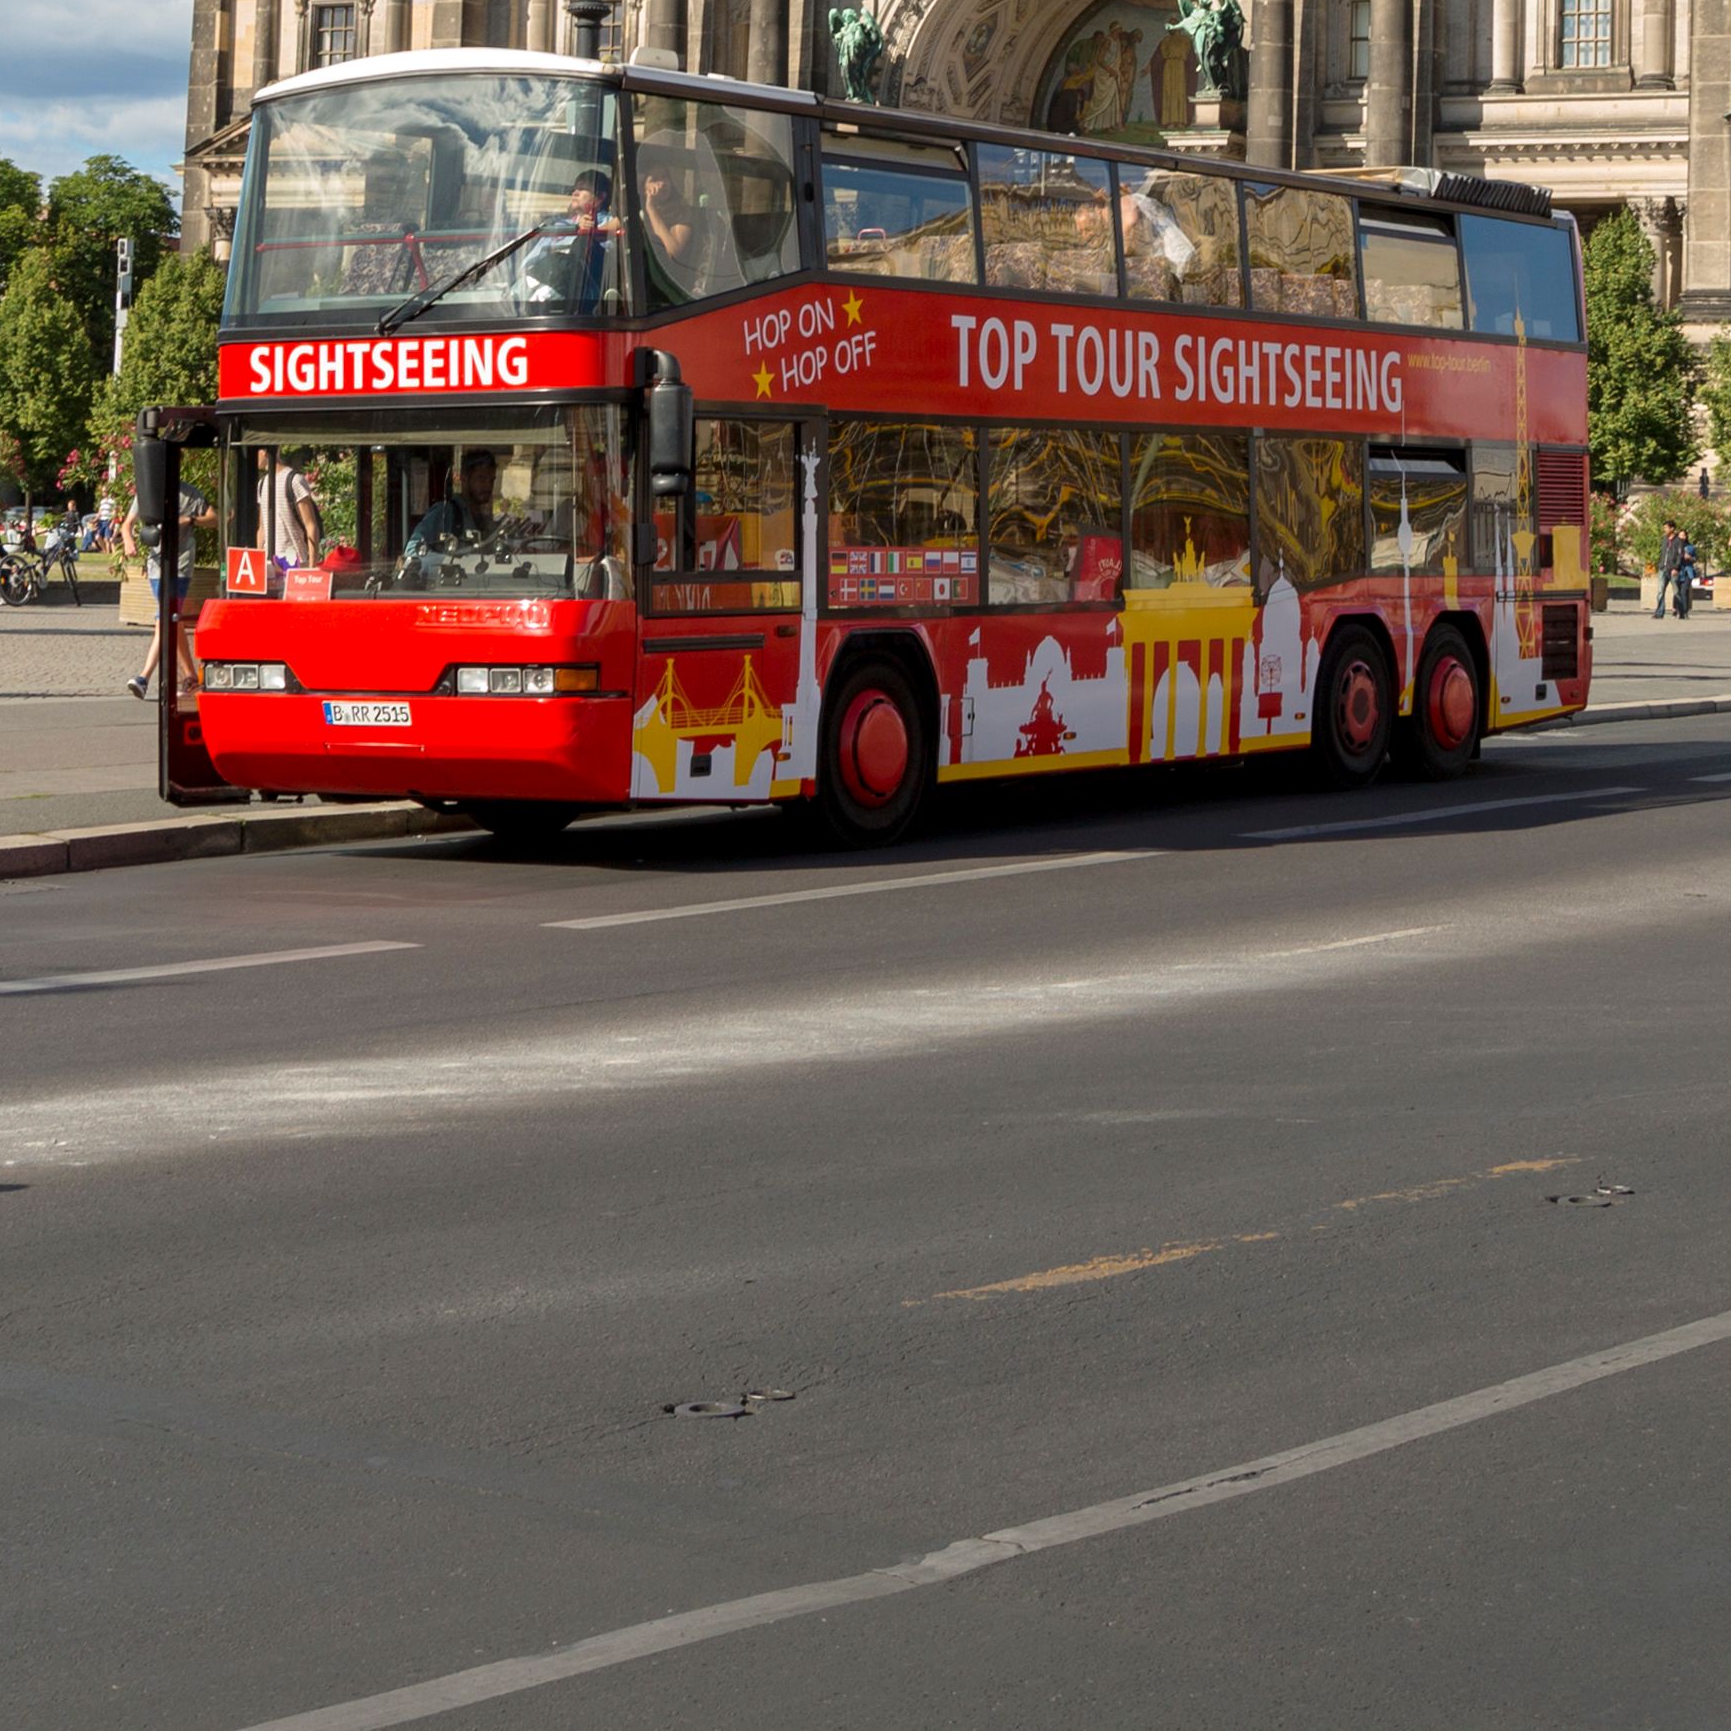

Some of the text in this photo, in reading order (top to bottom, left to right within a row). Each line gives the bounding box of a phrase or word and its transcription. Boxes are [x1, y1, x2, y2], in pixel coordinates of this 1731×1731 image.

[744, 297, 835, 356] HOP ON
[249, 337, 528, 393] SIGHTSEEING
[781, 331, 876, 392] HOP OFF
[951, 314, 1402, 413] TOP TOUR SIGHTSEEING
[1407, 353, 1491, 374] www.top-tour.berlin
[235, 551, 256, 585] A
[333, 705, 410, 723] B RR 2515
